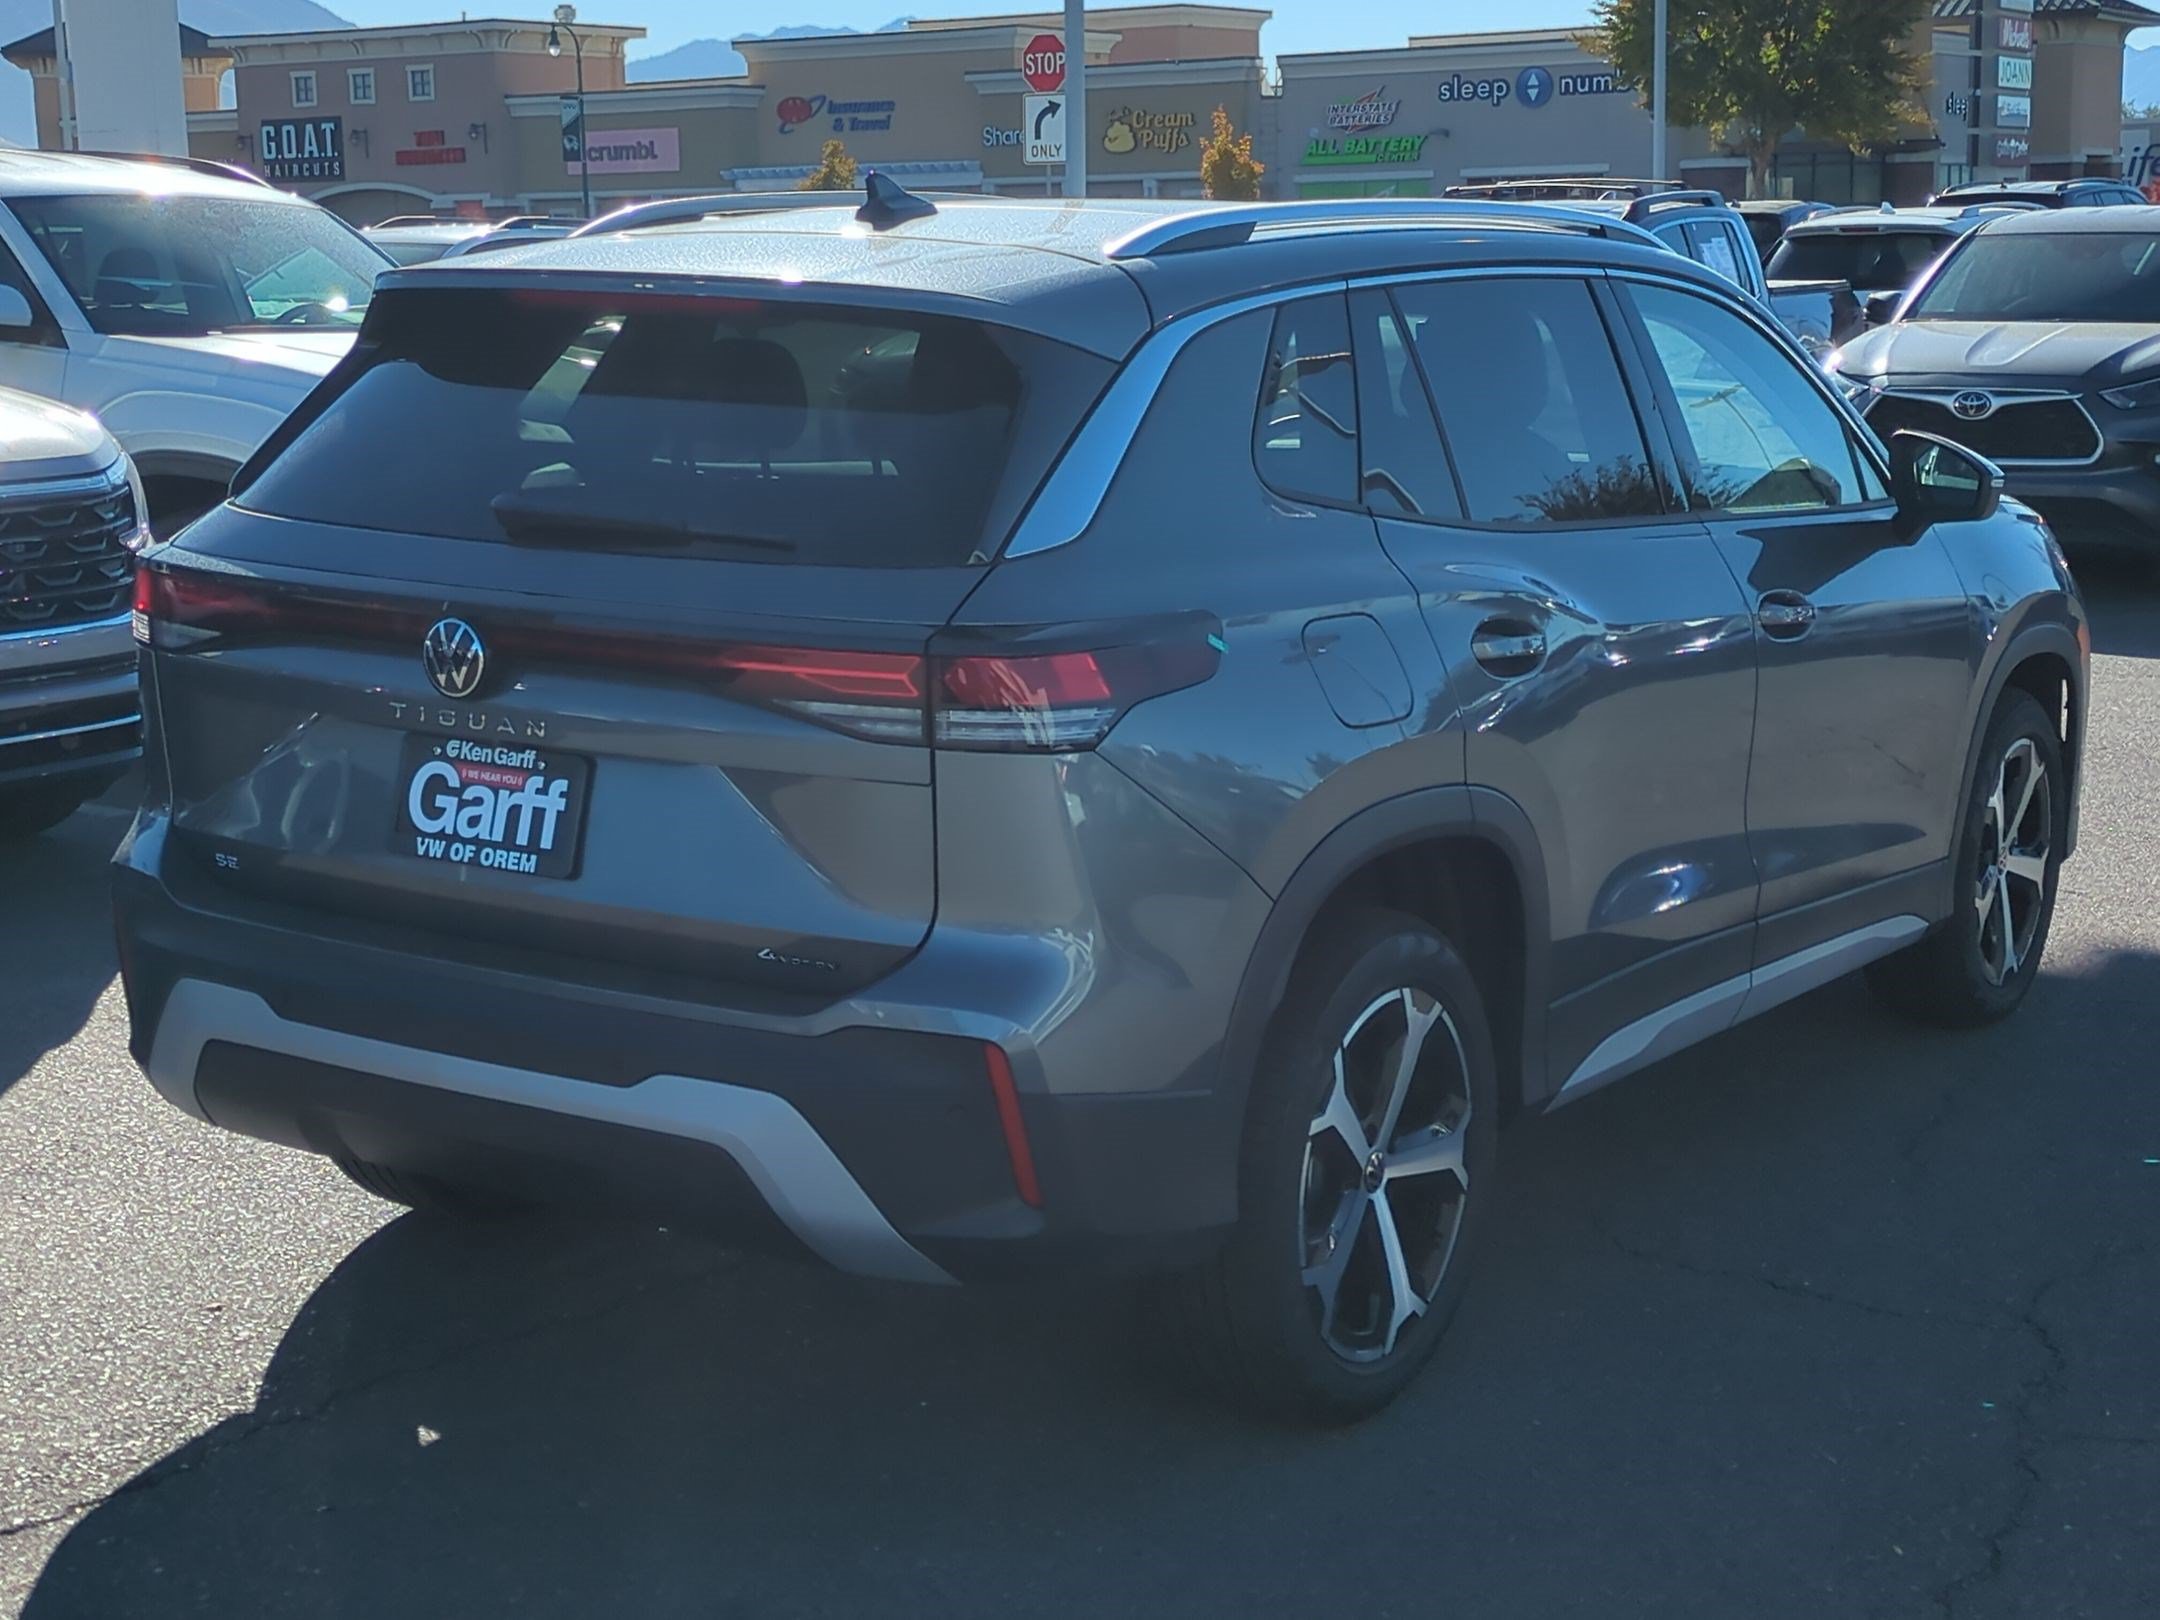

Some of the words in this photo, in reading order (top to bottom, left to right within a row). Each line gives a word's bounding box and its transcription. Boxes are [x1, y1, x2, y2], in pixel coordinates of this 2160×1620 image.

[1025, 52, 1066, 75] STOP
[2000, 61, 2030, 84] JOANN
[1440, 77, 1508, 104] sleep
[1131, 110, 1194, 129] Cream
[1328, 103, 1394, 114] INTERSTATE
[1329, 113, 1391, 126] BATTERIES
[262, 122, 338, 160] G.O.A.T.
[588, 140, 658, 161] crumbl
[1031, 143, 1062, 158] ONLY
[1138, 129, 1190, 153] Puffs
[1307, 139, 1343, 156] ALL
[1344, 135, 1428, 154] BATTERY
[264, 161, 341, 178] HAIRCUTS
[389, 701, 546, 737] TIGUAN
[460, 741, 493, 763] Ken
[493, 746, 537, 769] Garff
[480, 771, 501, 782] HEAR
[502, 774, 517, 785] YOU
[408, 760, 569, 850] Garff
[215, 853, 240, 870] SE
[416, 836, 446, 859] VW
[449, 842, 477, 863] OF
[479, 847, 538, 874] OREM
